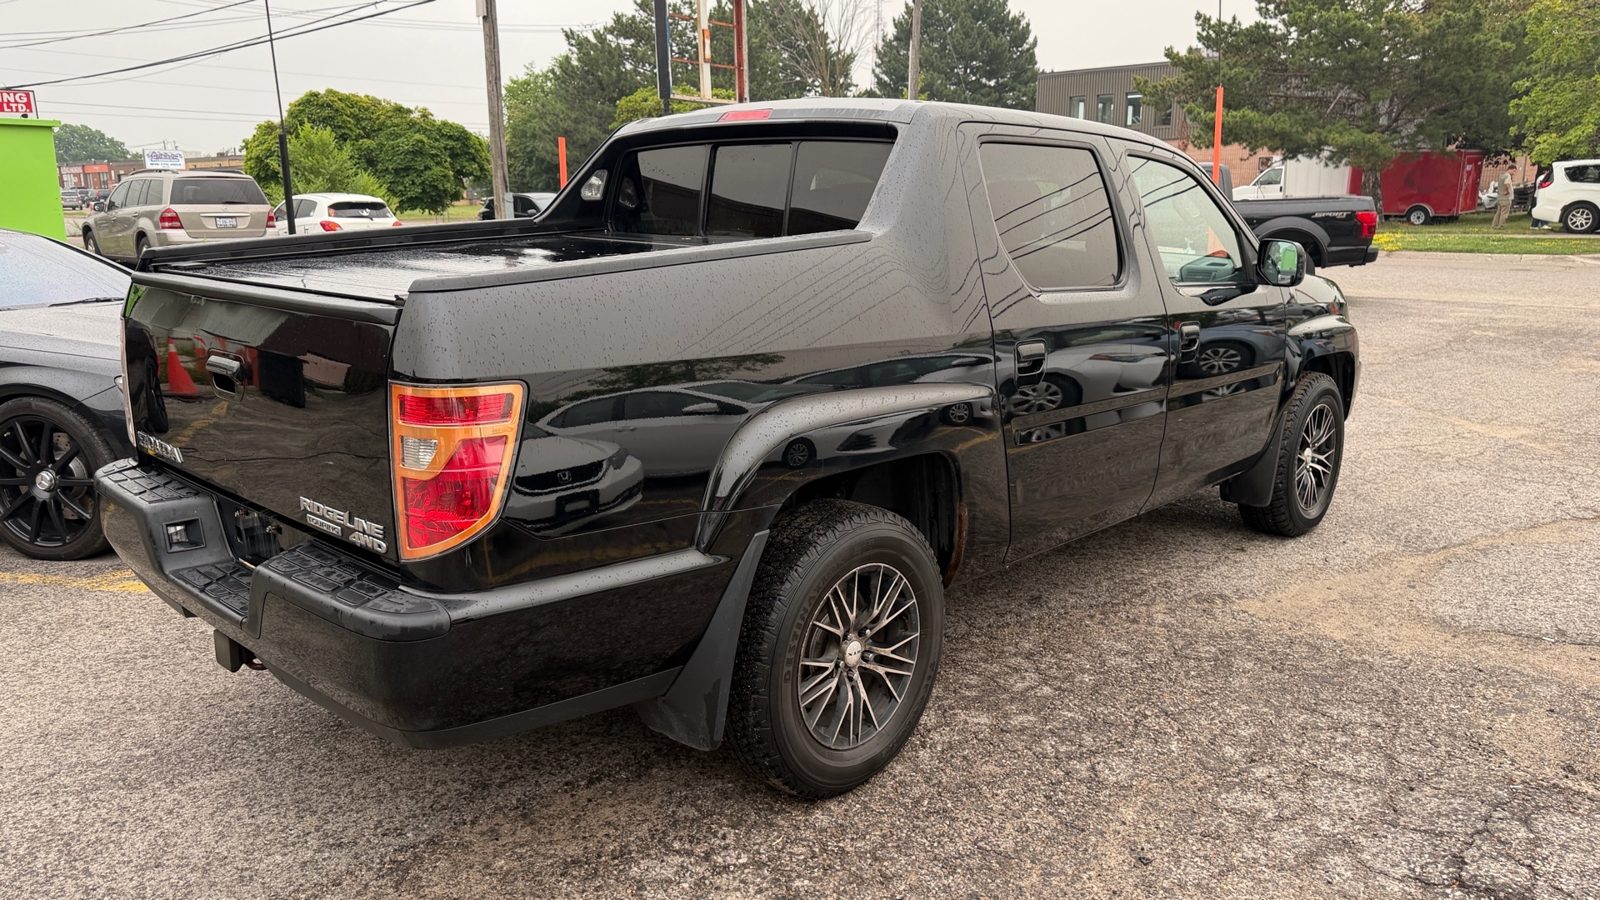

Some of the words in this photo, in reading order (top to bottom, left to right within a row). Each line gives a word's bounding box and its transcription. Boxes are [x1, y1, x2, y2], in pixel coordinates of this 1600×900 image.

[3, 103, 30, 112] LTD.
[299, 496, 384, 539] RIDGELINE
[349, 531, 387, 554] 4WD
